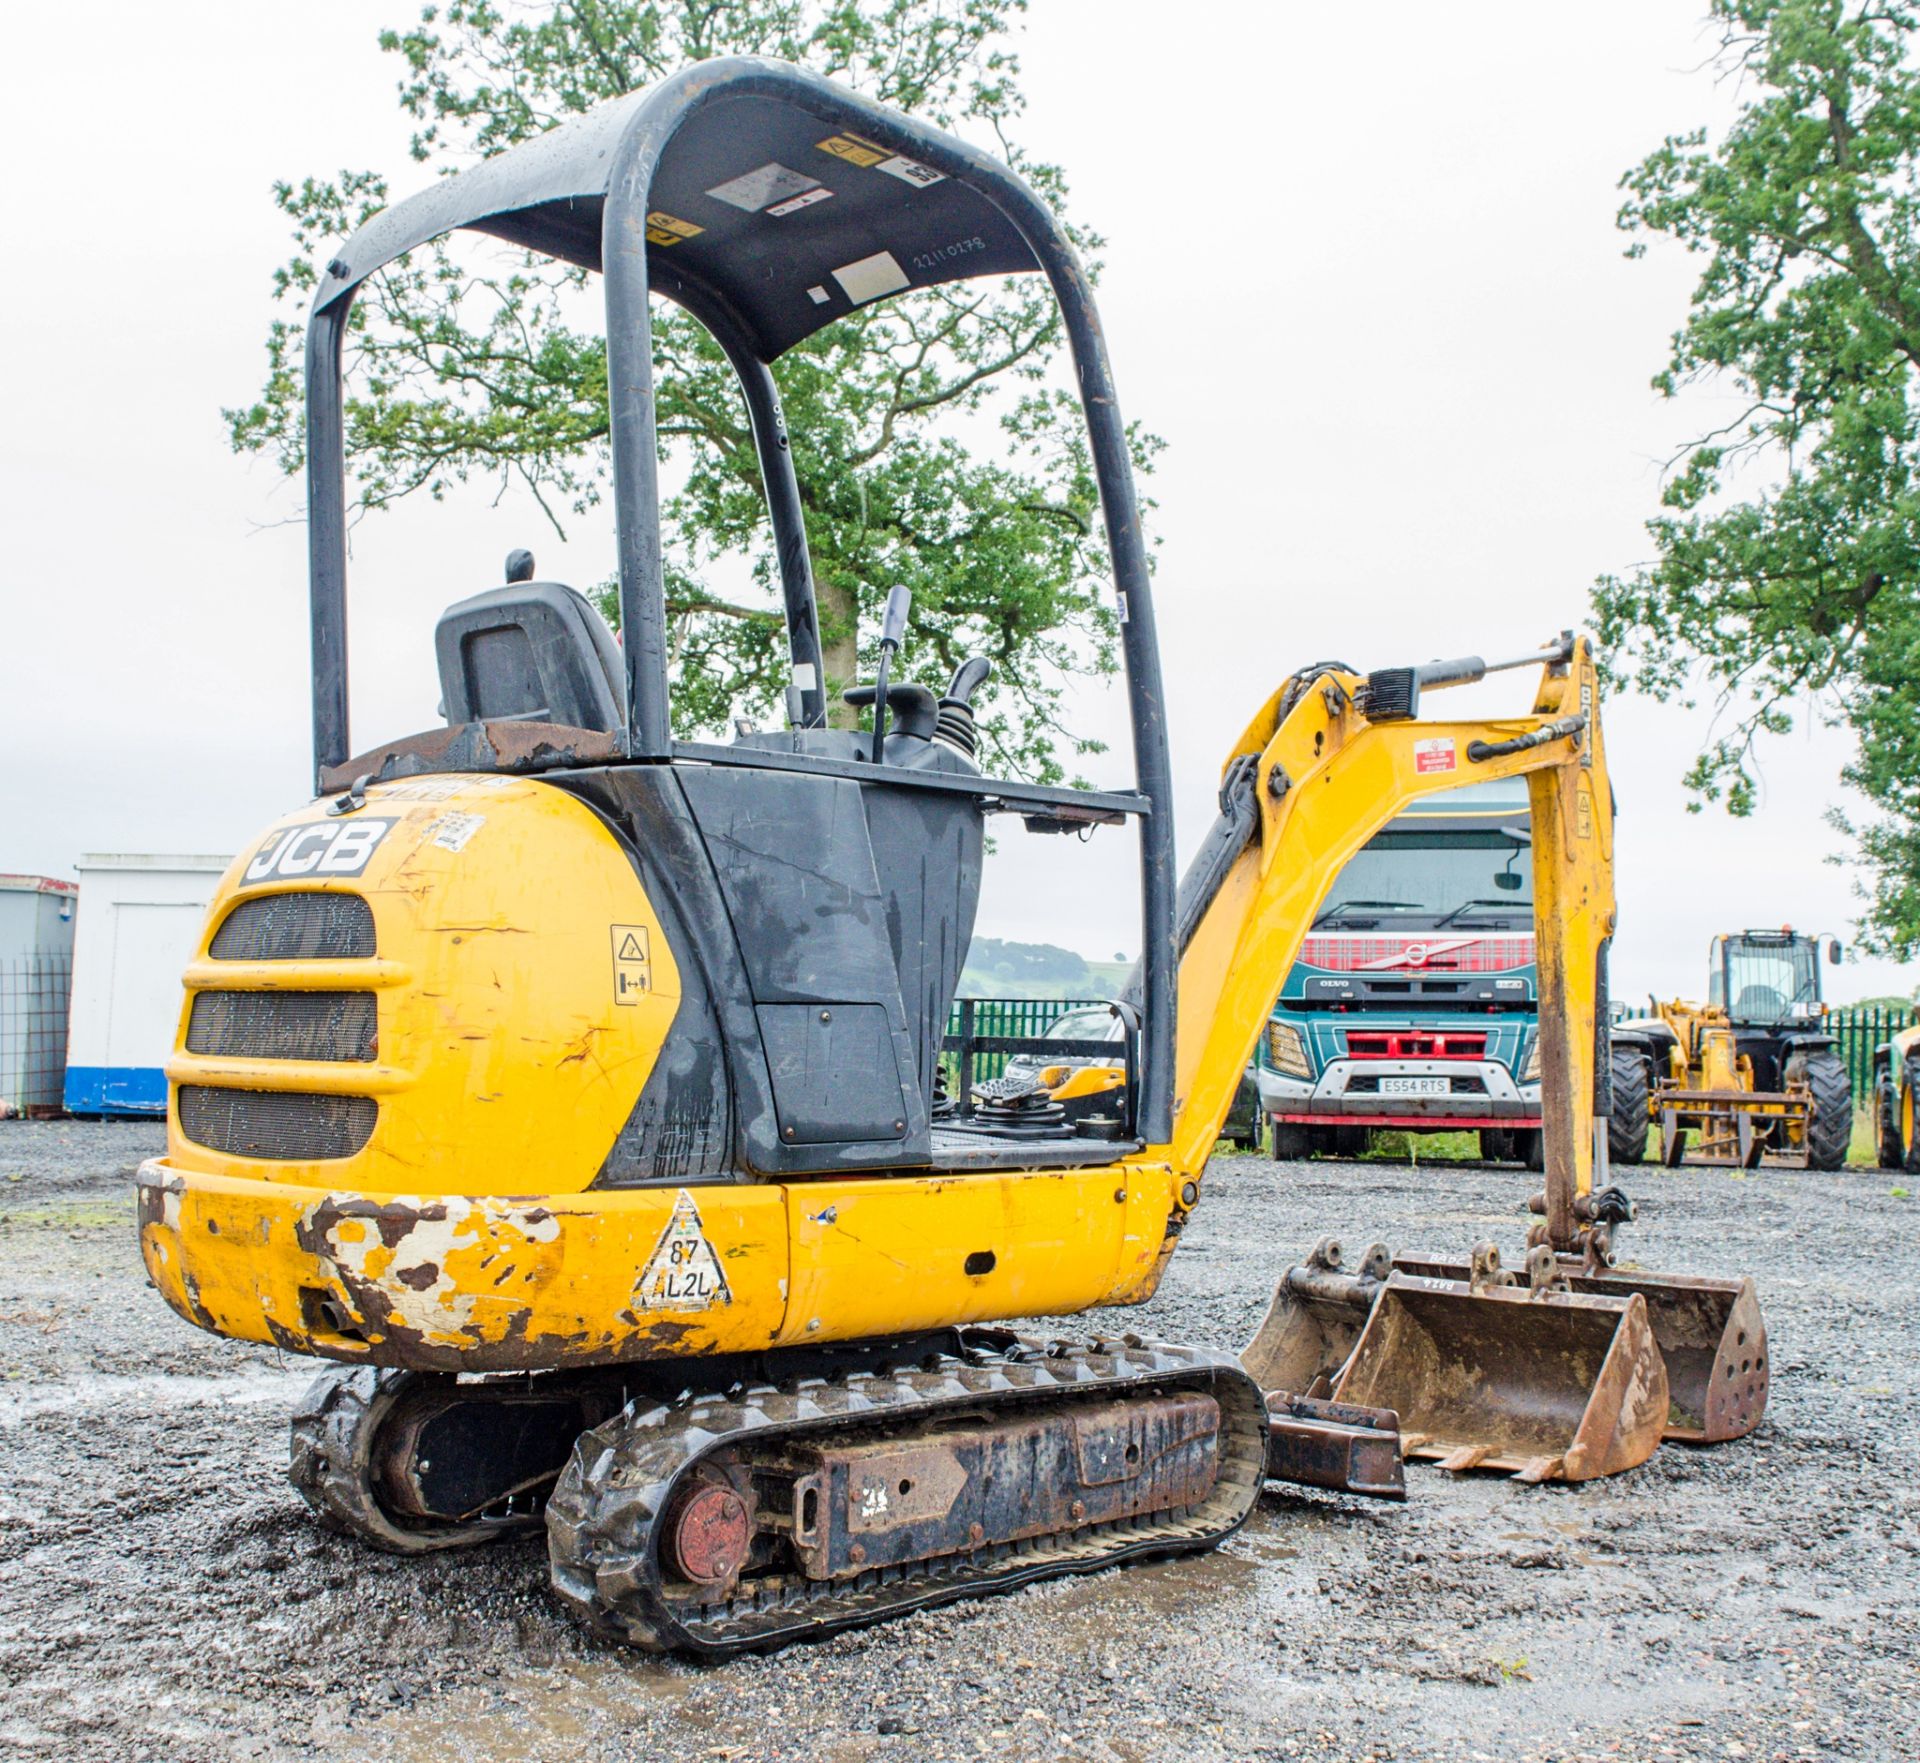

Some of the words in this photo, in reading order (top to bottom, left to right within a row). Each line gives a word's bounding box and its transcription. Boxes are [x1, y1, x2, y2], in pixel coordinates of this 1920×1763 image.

[246, 821, 388, 880] JCB
[1385, 1080, 1416, 1092] ES54
[1420, 1080, 1445, 1092] RTS
[670, 1240, 698, 1264] 87
